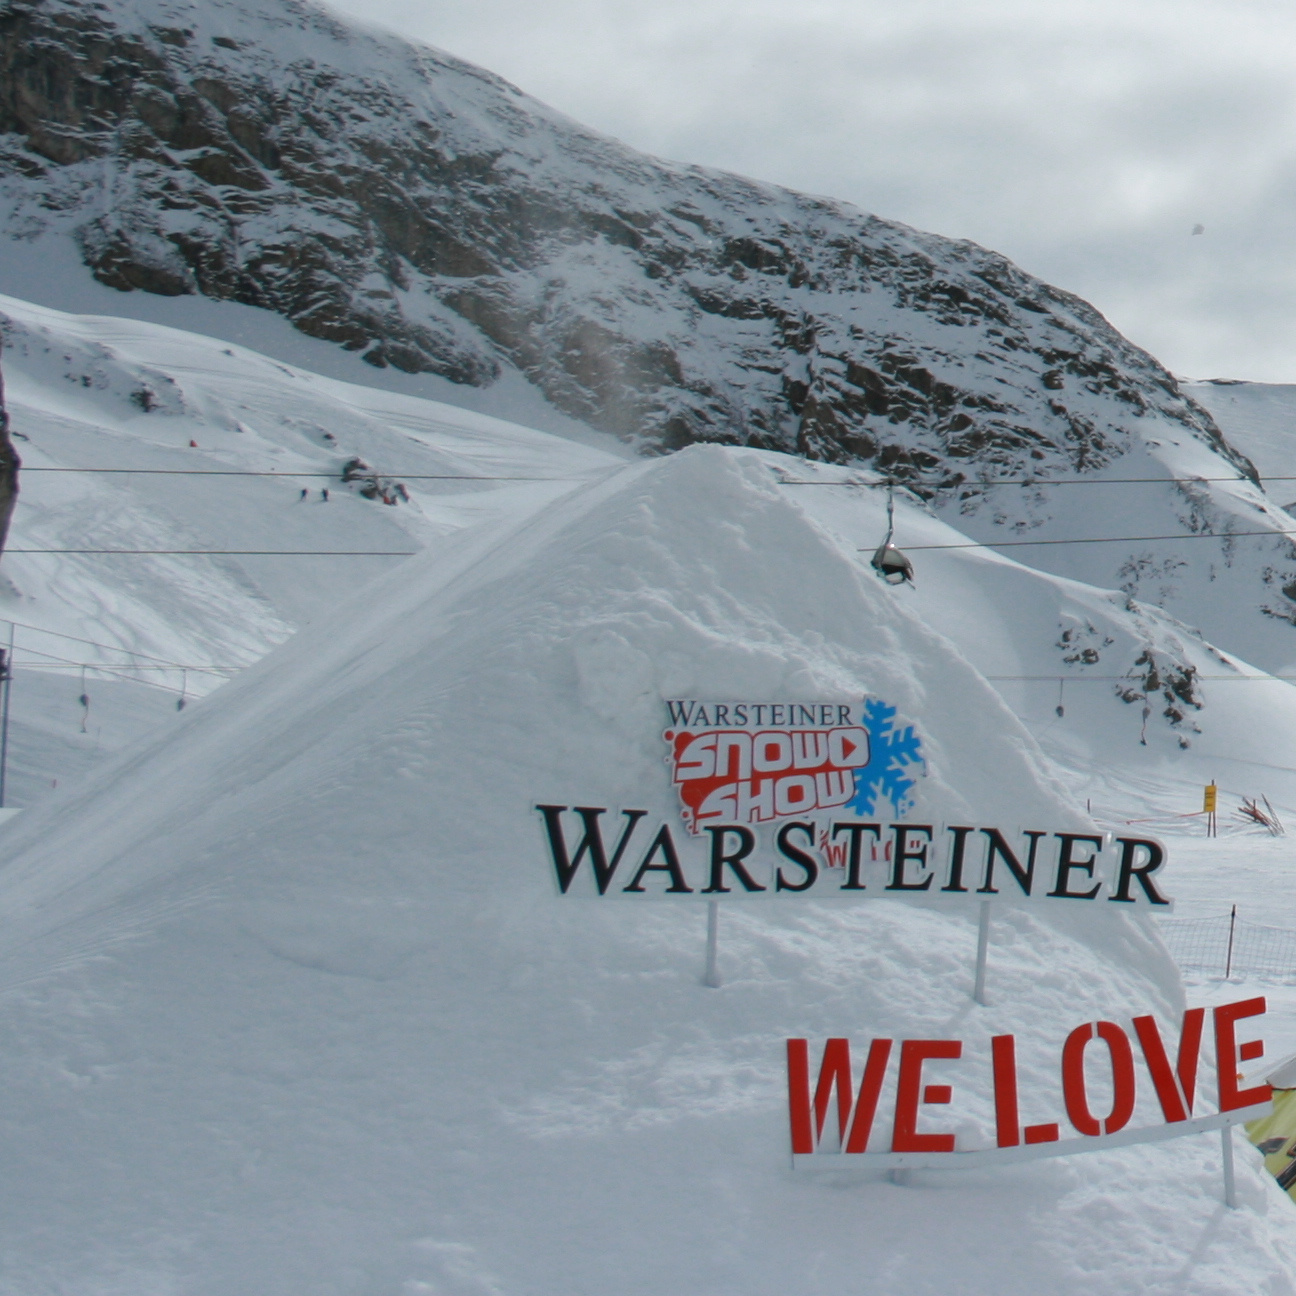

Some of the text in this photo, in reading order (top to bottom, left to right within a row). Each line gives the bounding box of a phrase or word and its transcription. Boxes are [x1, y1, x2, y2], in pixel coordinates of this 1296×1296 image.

[666, 700, 854, 727] WARSTEINER
[692, 769, 855, 834] SHOW
[535, 804, 1174, 905] WARSTEINER
[786, 1038, 963, 1154] WE
[991, 996, 1274, 1149] LOVE
